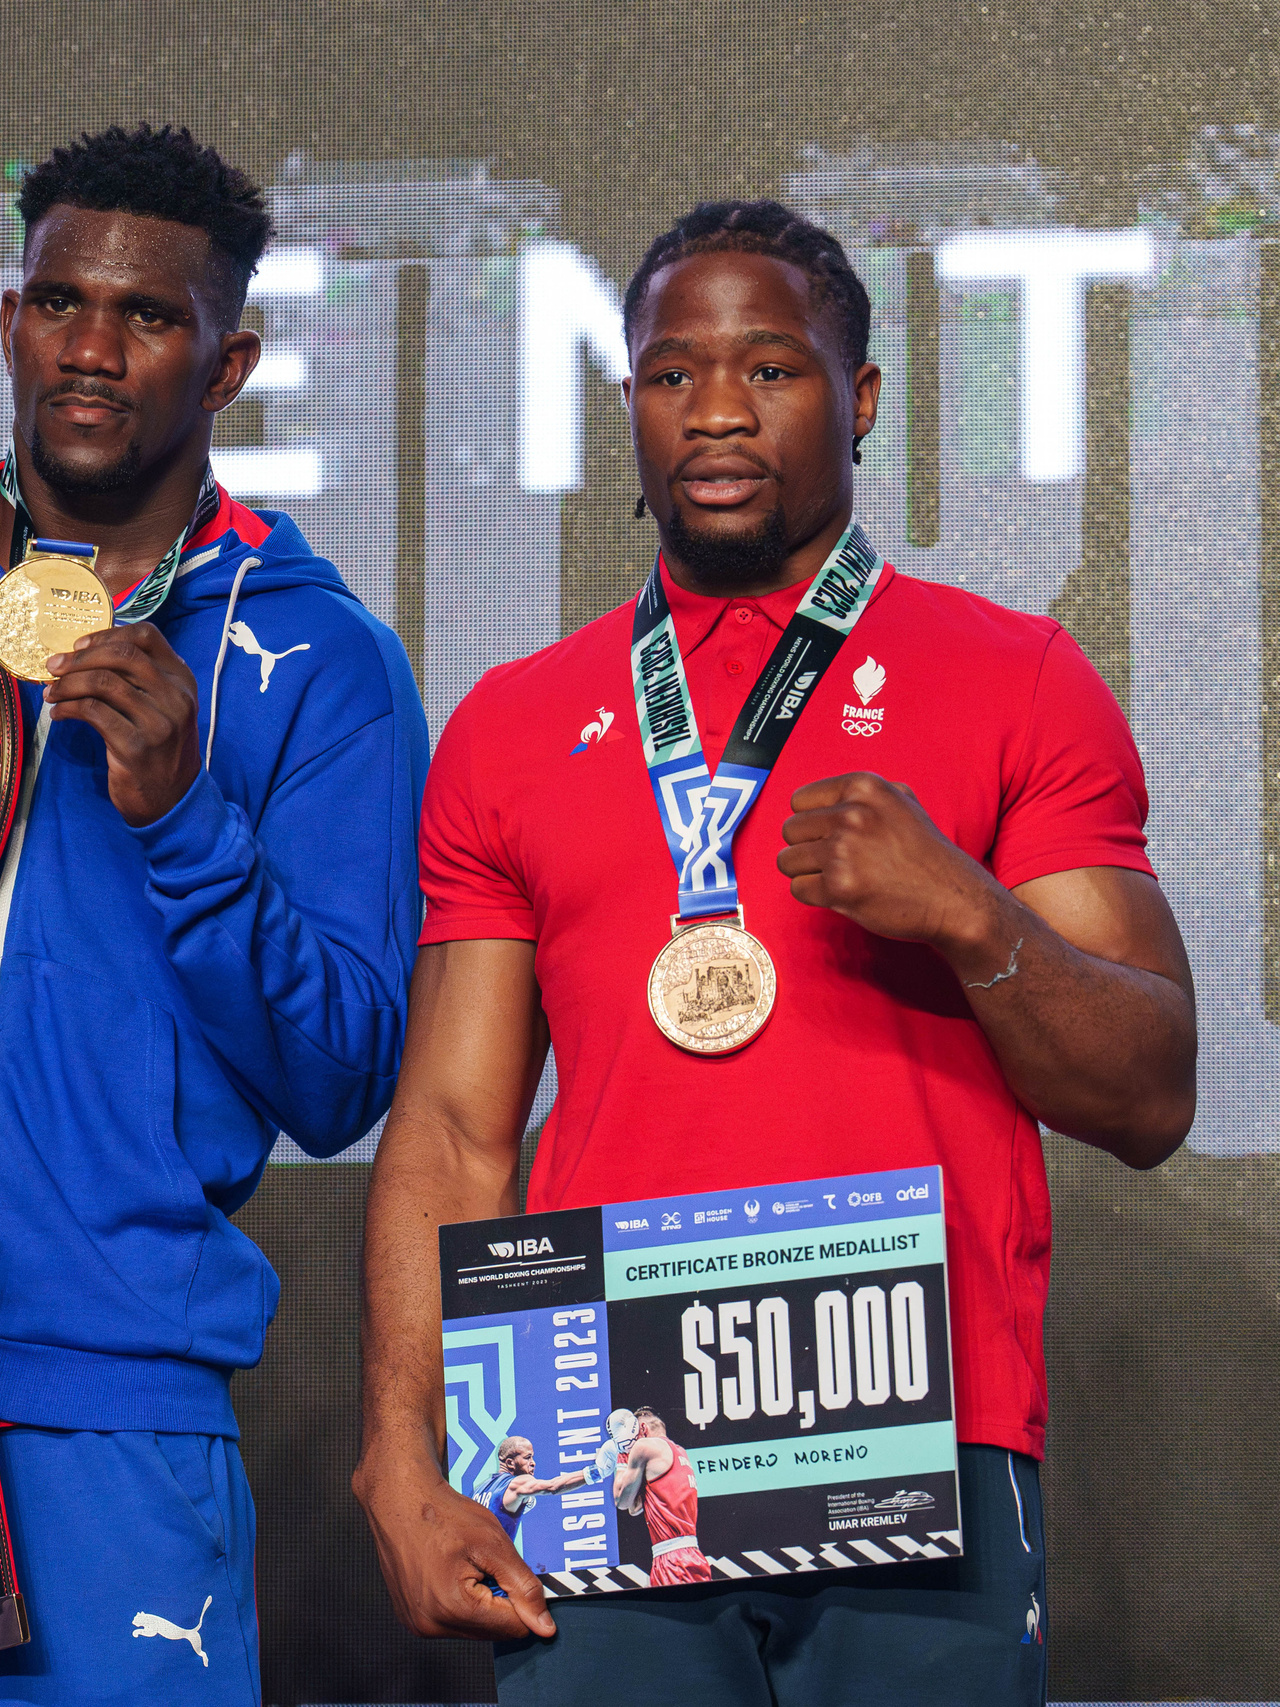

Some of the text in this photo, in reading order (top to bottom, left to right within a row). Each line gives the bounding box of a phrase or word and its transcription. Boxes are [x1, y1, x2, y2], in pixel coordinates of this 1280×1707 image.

[73, 590, 103, 605] IBA
[810, 569, 860, 620] 2023
[639, 630, 691, 752] TASHKENT 2023
[743, 636, 803, 740] MENS WORLD BOXING CHAMPIONSHIPS
[775, 689, 805, 719] IBA
[842, 703, 885, 720] FRANCE
[862, 1192, 882, 1203] OFB
[896, 1183, 929, 1201] artel
[706, 1208, 732, 1217] GOLDEN
[706, 1215, 728, 1223] HOUSE
[630, 1218, 650, 1229] IBA
[516, 1237, 555, 1256] IBA
[626, 1233, 920, 1282] CERTIFICATE BRONZE MEDALLIST
[458, 1263, 586, 1285] MENS WORLD BOXING CHAMPIONSHIPS
[497, 1281, 529, 1289] TASHKENT
[553, 1308, 600, 1392] 2023
[681, 1281, 930, 1431] $50,000
[697, 1453, 778, 1474] FENDERO
[794, 1445, 868, 1465] MORENO
[827, 1492, 850, 1501] President
[827, 1499, 858, 1508] International
[828, 1505, 870, 1515] Association (IBA)
[828, 1513, 908, 1531] UMAR KREMLEV
